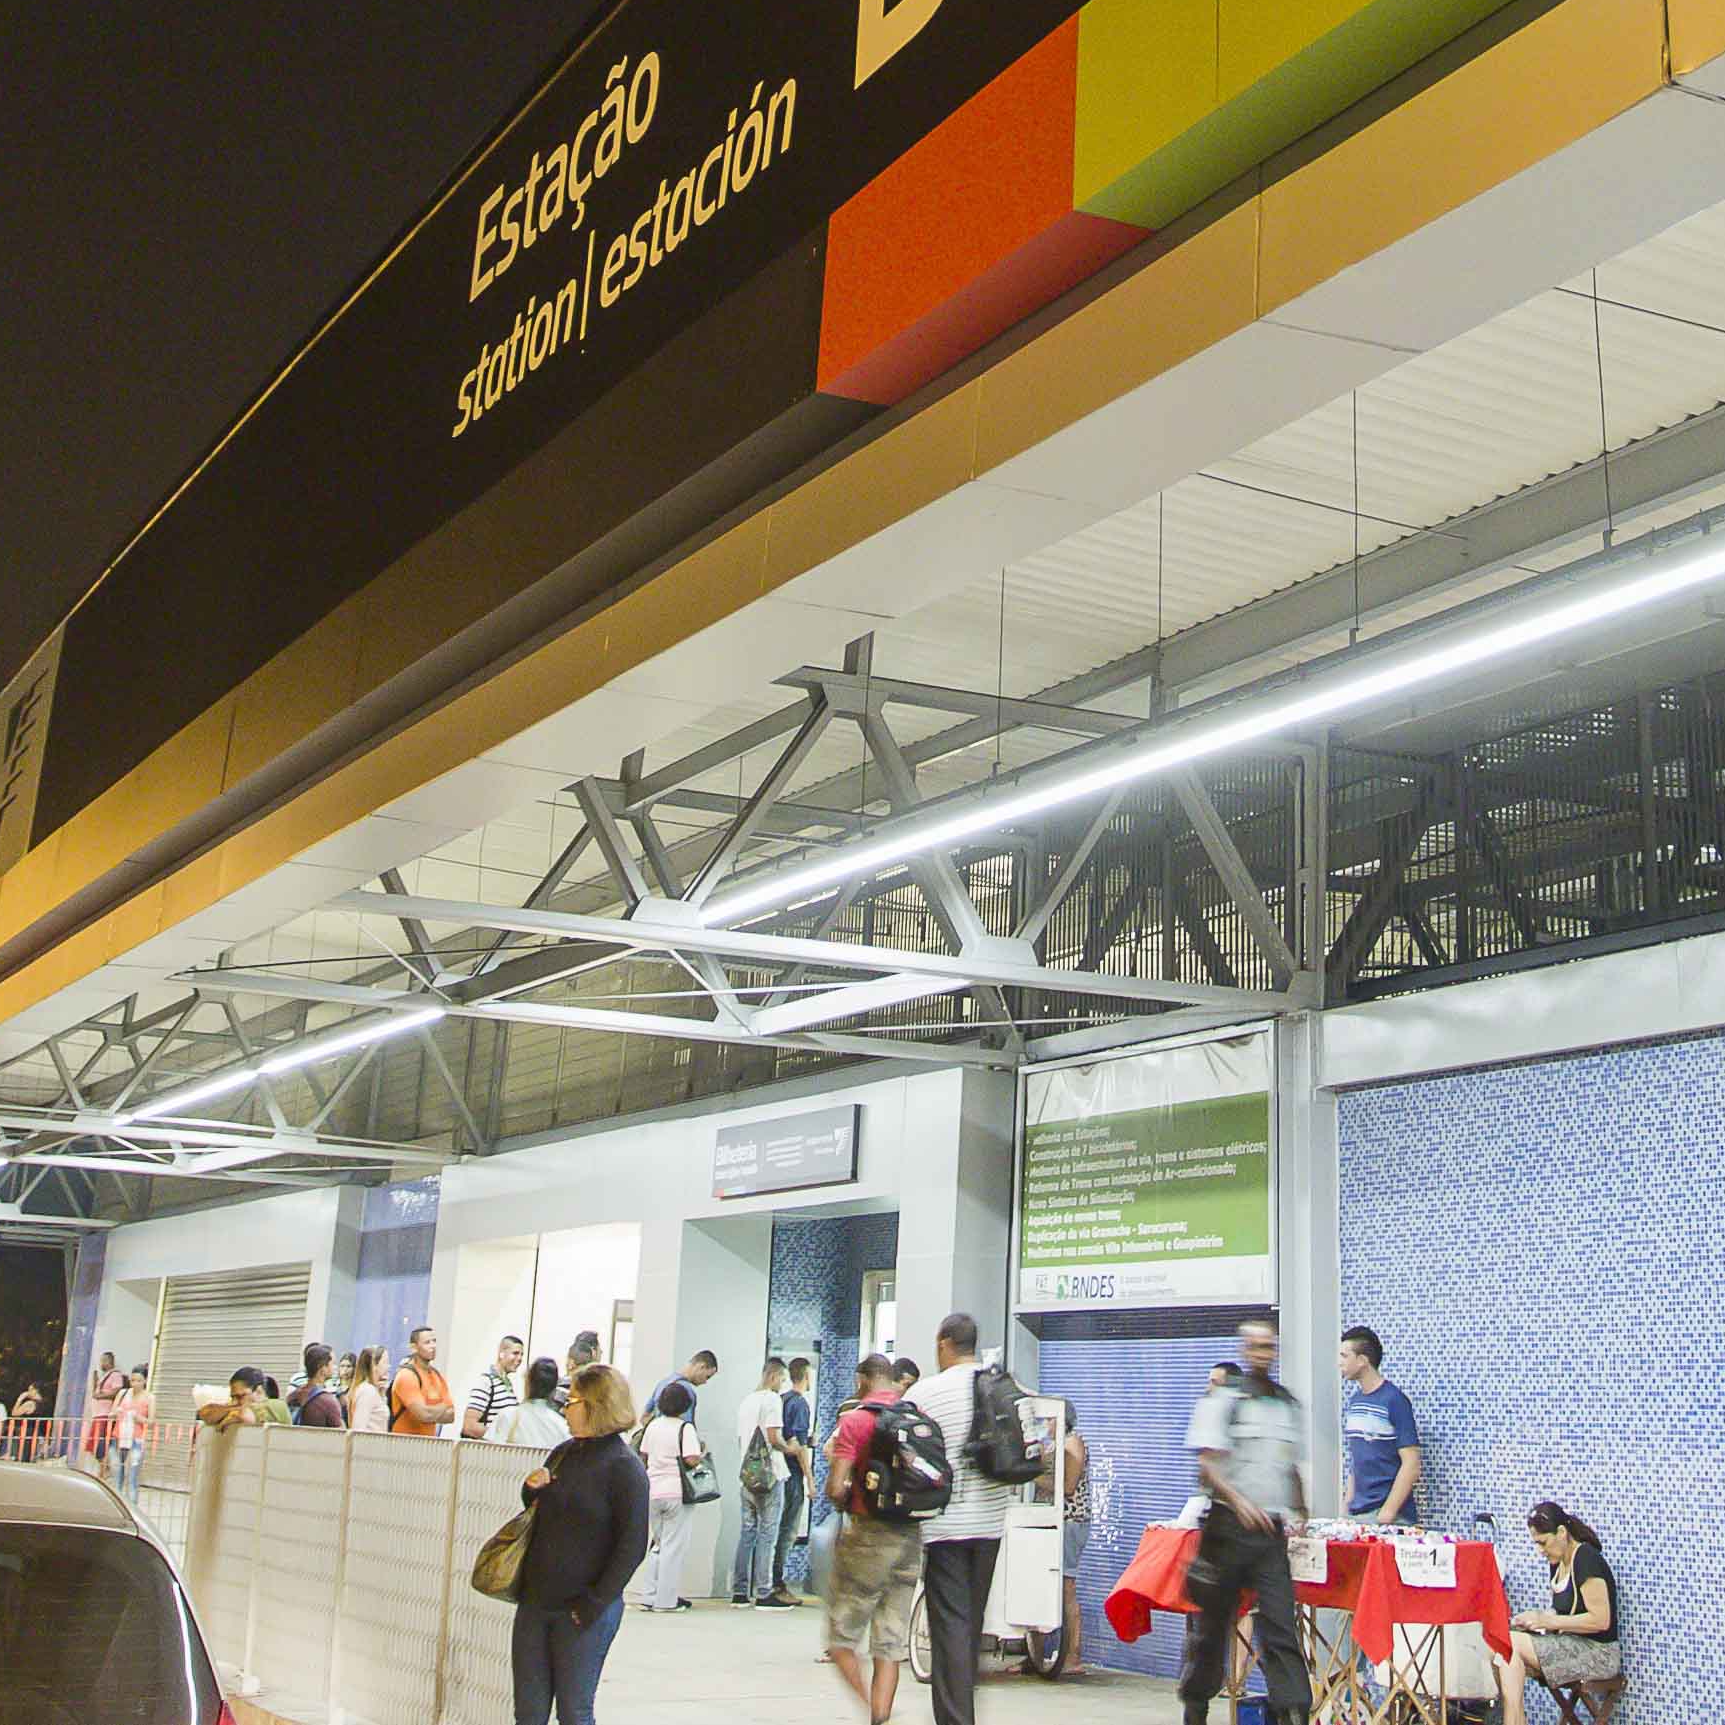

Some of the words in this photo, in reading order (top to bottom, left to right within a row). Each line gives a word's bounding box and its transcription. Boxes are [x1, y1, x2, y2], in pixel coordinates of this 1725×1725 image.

[451, 277, 577, 439] station
[600, 77, 797, 309] estación
[469, 51, 660, 303] Estação
[1072, 1275, 1115, 1299] BNDES
